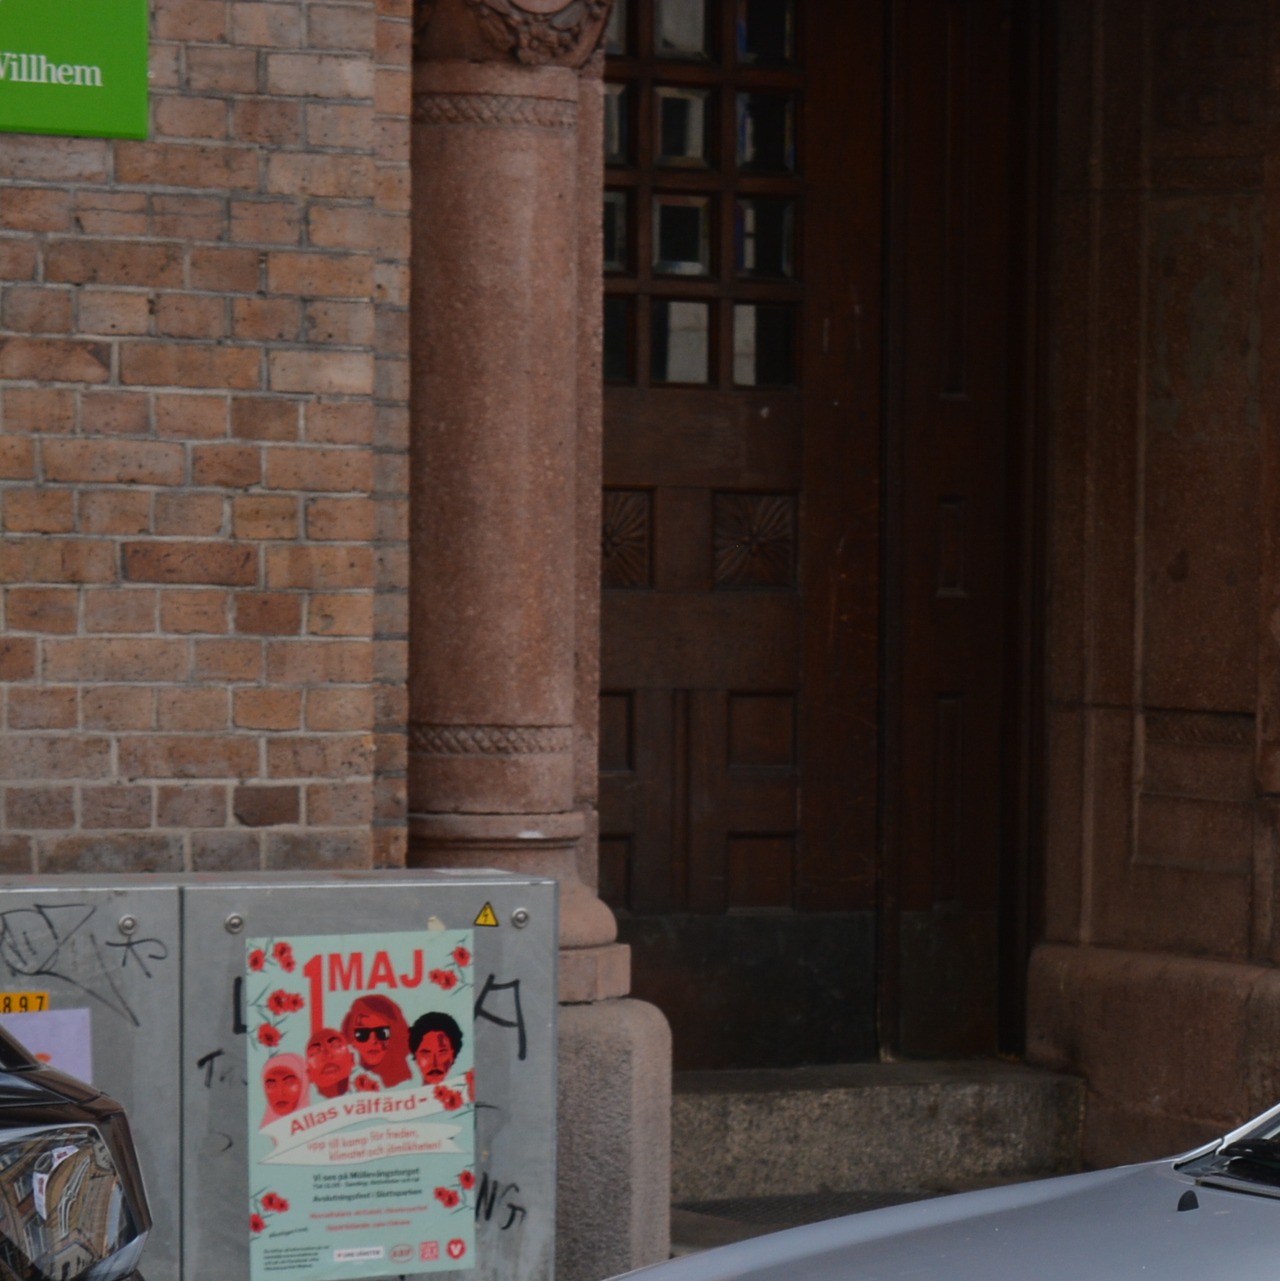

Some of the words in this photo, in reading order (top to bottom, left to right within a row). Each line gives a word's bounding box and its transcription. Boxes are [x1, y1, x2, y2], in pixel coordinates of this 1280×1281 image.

[0, 995, 45, 1014] 897
[303, 954, 324, 1031] 1
[328, 949, 424, 991] MAJ
[290, 1109, 338, 1135] Allas
[343, 1095, 428, 1115] välfärd-
